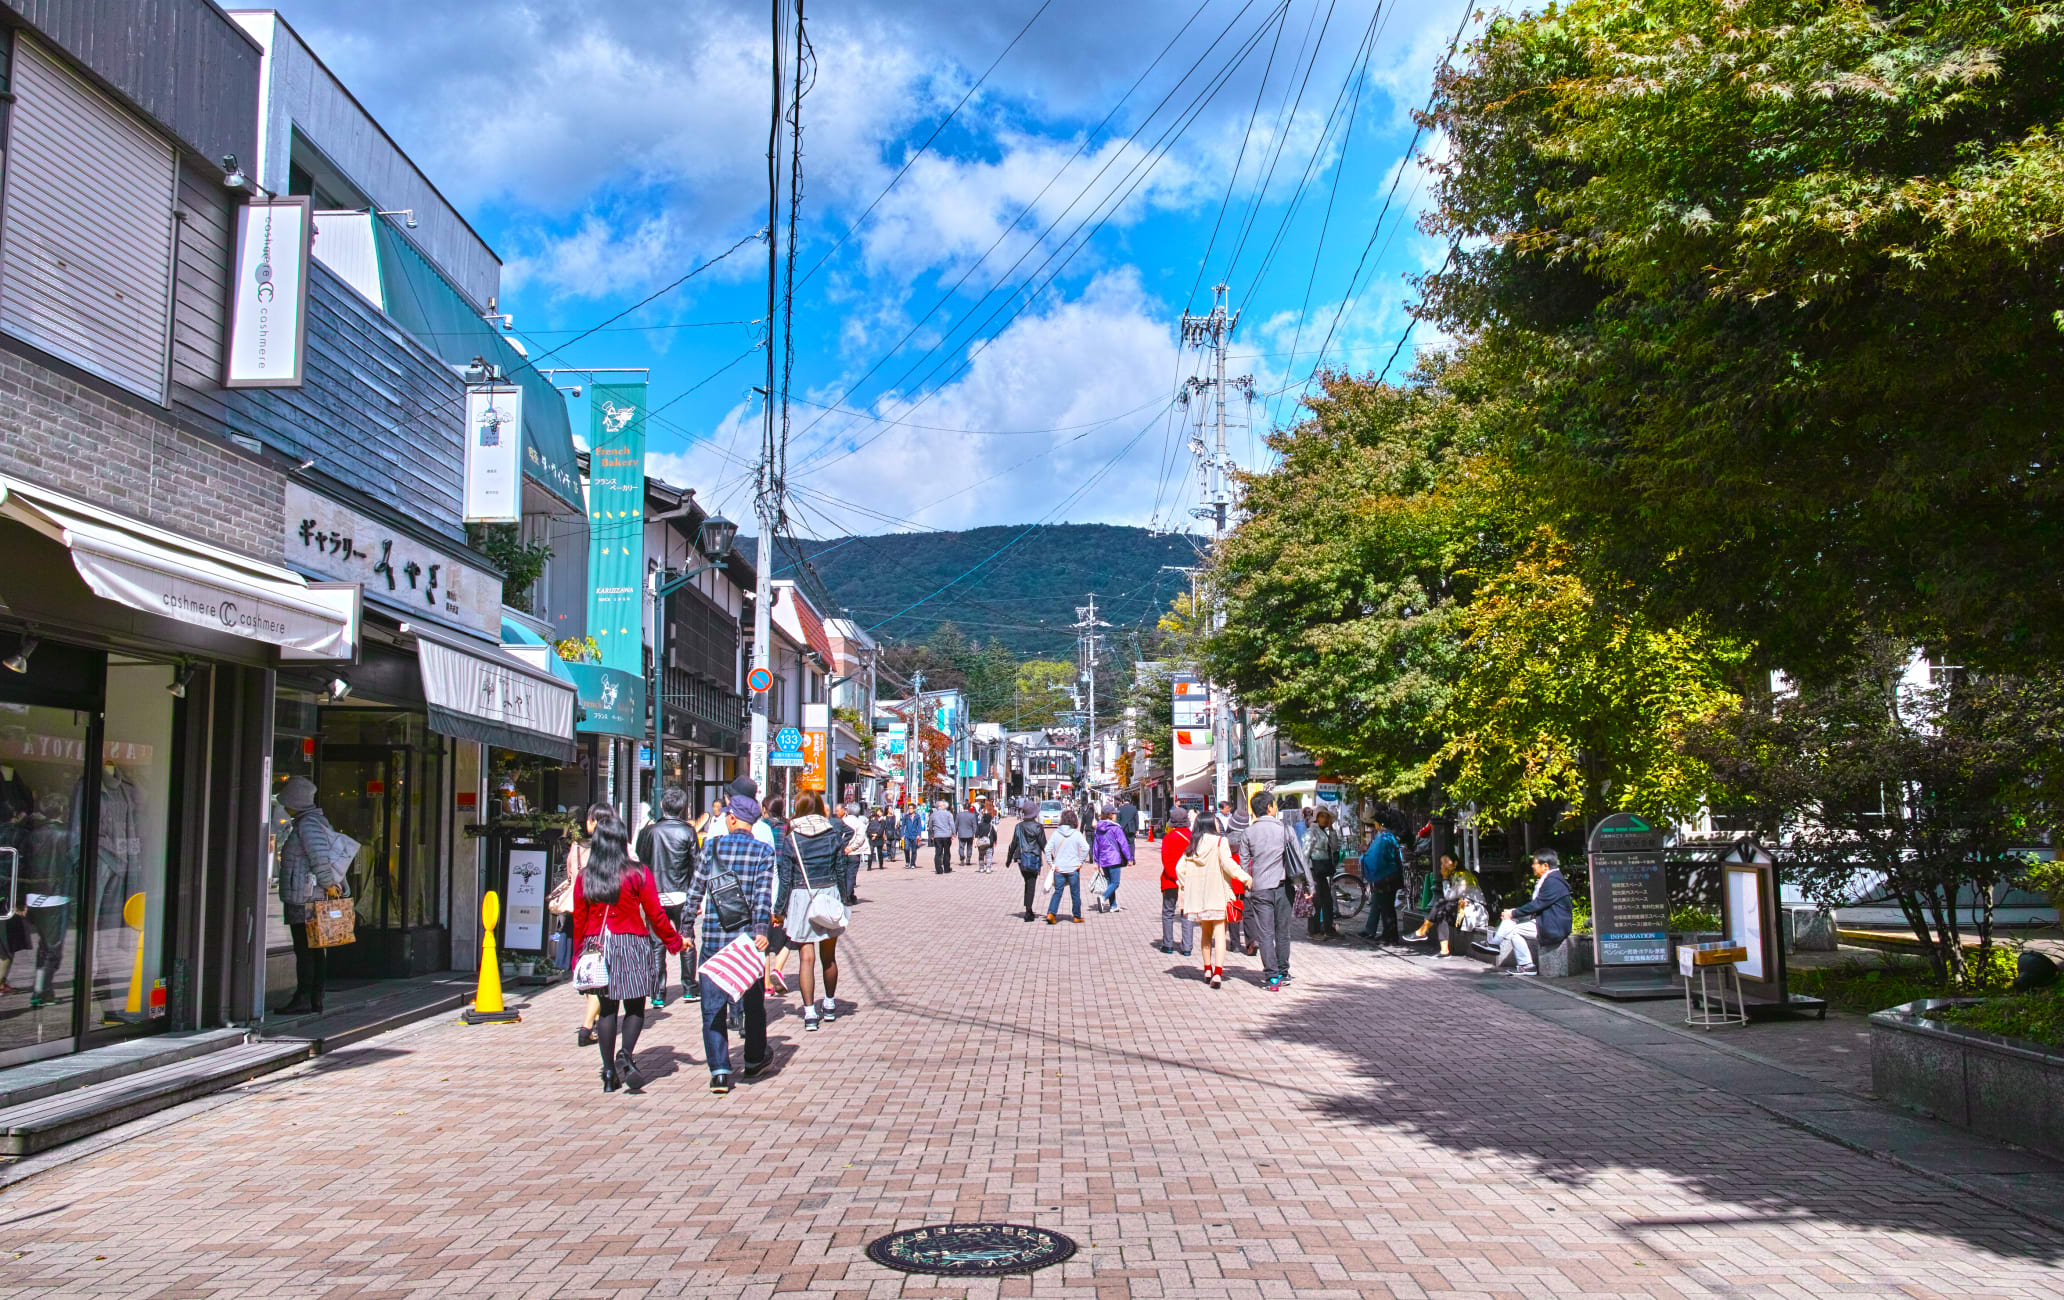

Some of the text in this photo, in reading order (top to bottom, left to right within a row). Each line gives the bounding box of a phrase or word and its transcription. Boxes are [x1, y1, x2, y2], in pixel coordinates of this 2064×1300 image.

[261, 216, 273, 277] cashmere
[258, 307, 269, 369] cashmere
[595, 445, 631, 456] French
[601, 457, 639, 468] Bakery
[593, 478, 617, 486] フランス
[298, 519, 367, 561] ギャラリー
[162, 593, 216, 617] cashmere
[240, 613, 285, 634] cashmere
[780, 734, 798, 745] 133
[1610, 932, 1656, 940] INFORMATION
